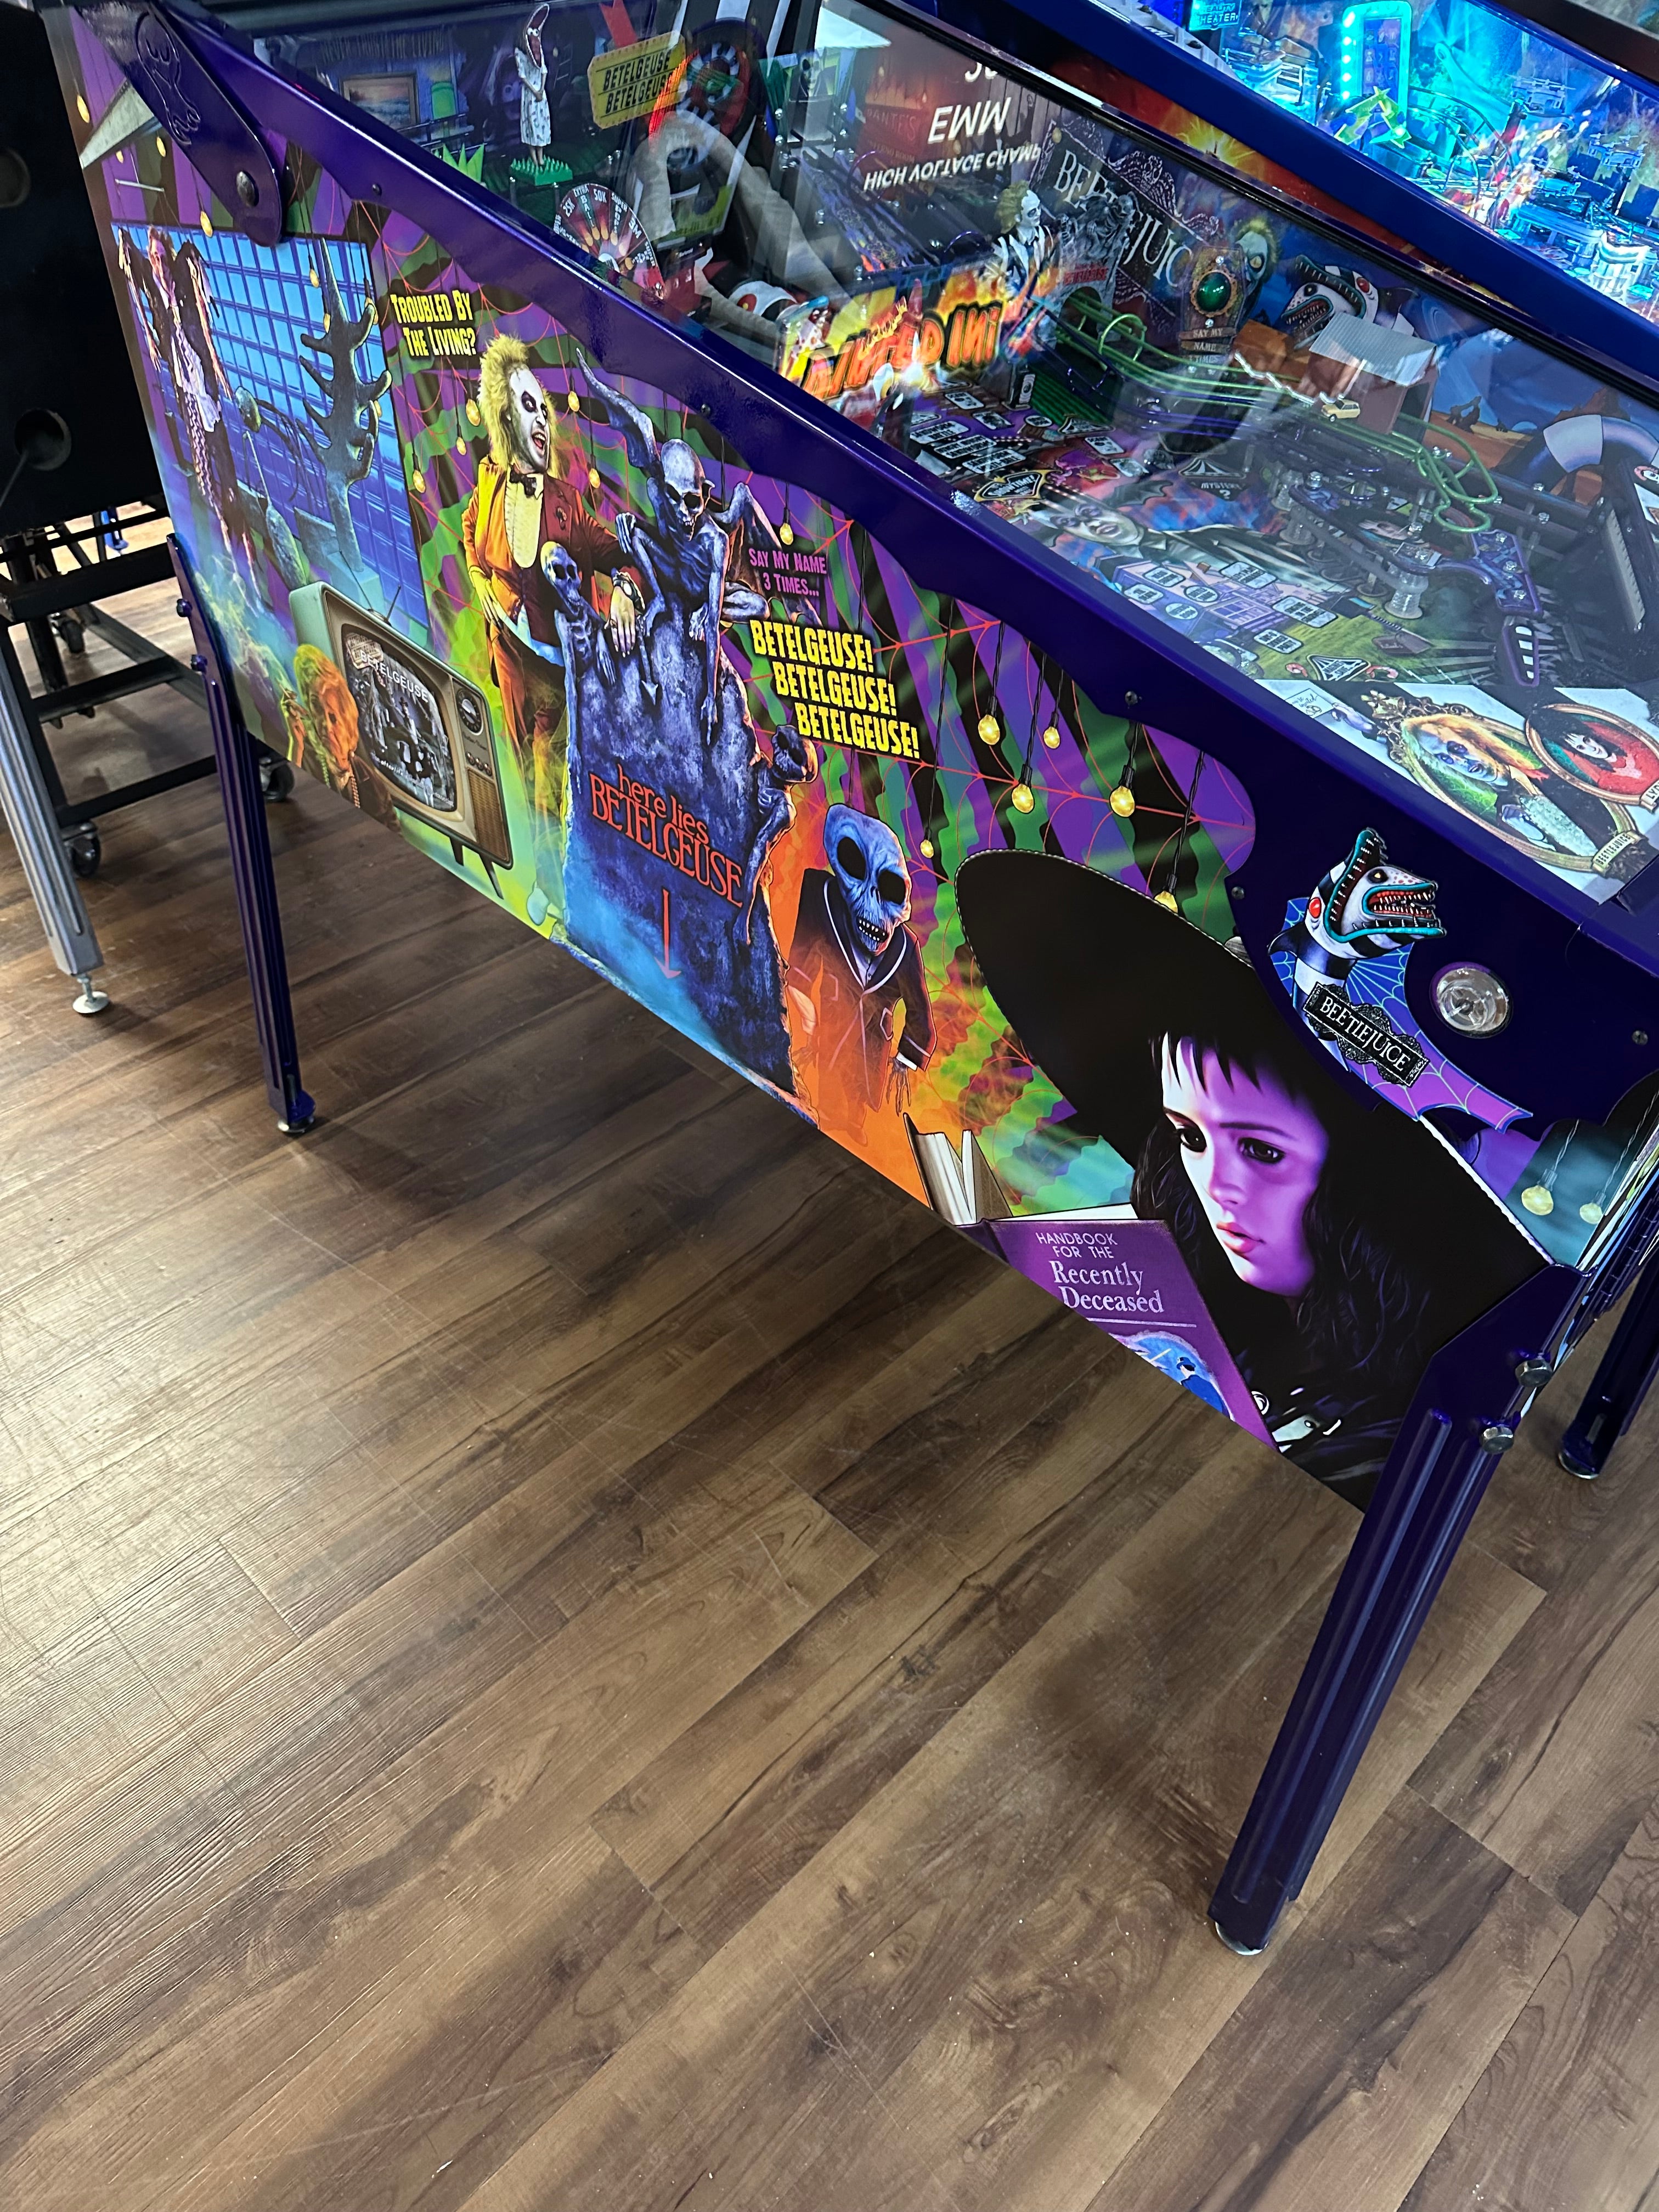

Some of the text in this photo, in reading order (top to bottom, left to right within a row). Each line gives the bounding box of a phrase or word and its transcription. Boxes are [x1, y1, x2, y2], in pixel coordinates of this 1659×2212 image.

[603, 49, 673, 91] BETELGEUSE
[390, 290, 473, 324] TROUBLED BY
[402, 326, 477, 357] THE LIVING?
[1193, 341, 1216, 352] NAME
[748, 548, 827, 574] SAY MY NAME
[763, 572, 820, 597] 3 TIMES...
[749, 619, 874, 673] BETELGEUSE!
[359, 650, 430, 703] BETELGEUSE
[772, 661, 897, 716] BETELGEUSE!
[794, 702, 921, 759] BETELGEUSE!
[617, 763, 709, 845] here lies
[590, 773, 743, 909] BETELGEUSE
[1595, 833, 1631, 865] BEETLEJUICE
[1320, 996, 1410, 1071] BEETLEJUICE
[1035, 1232, 1118, 1245] HANDBOOK
[1052, 1246, 1115, 1259] FOR THE
[1048, 1260, 1143, 1295] Recently
[1058, 1285, 1165, 1313] Deceased
